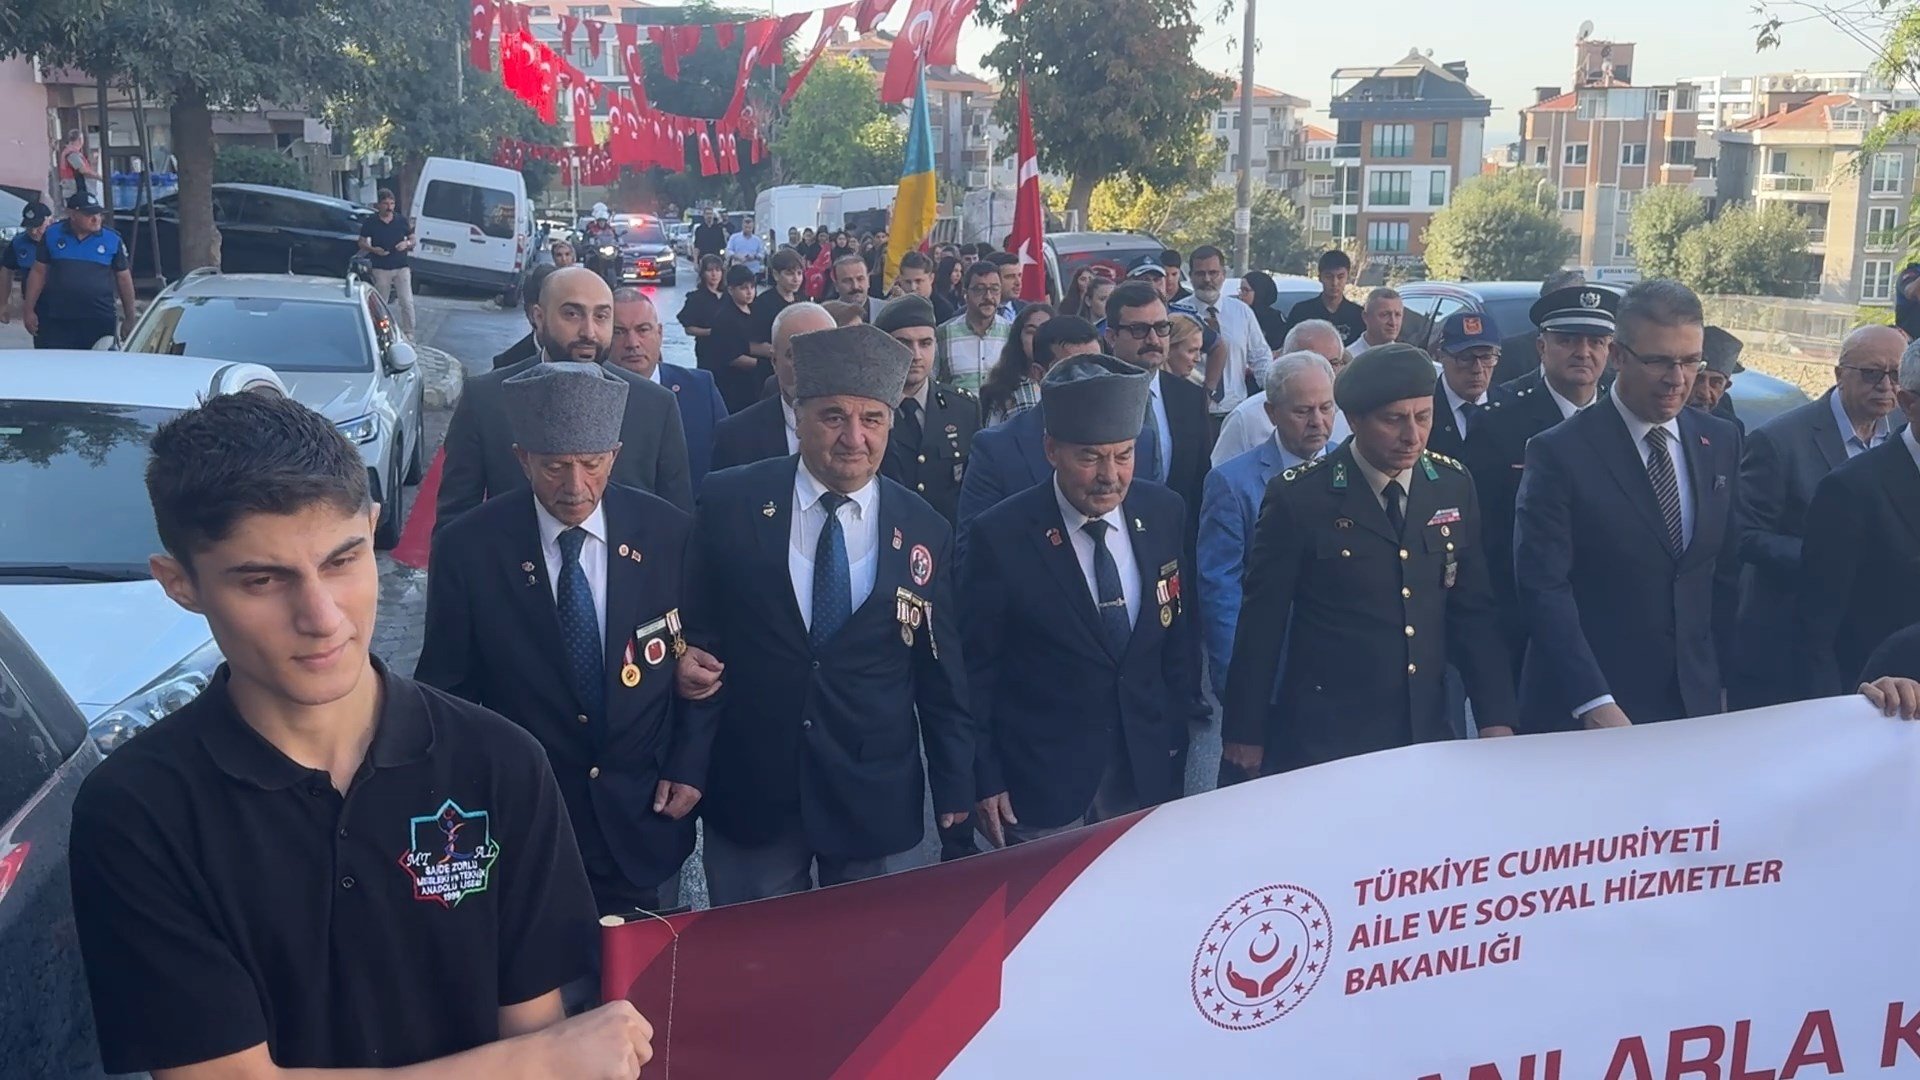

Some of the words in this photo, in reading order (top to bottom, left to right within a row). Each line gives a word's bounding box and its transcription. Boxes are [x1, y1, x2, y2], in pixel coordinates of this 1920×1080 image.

[1353, 857, 1490, 906] TÜRKİYE
[1497, 819, 1720, 879] CUMHURİYETİ
[1347, 914, 1420, 952] AİLE
[1427, 903, 1468, 935] VE
[1474, 882, 1596, 926] SOSYAL
[1604, 859, 1784, 904] HİZMETLER
[1344, 932, 1522, 996] BAKANLIĞI
[1416, 1009, 1844, 1080] ARLA
